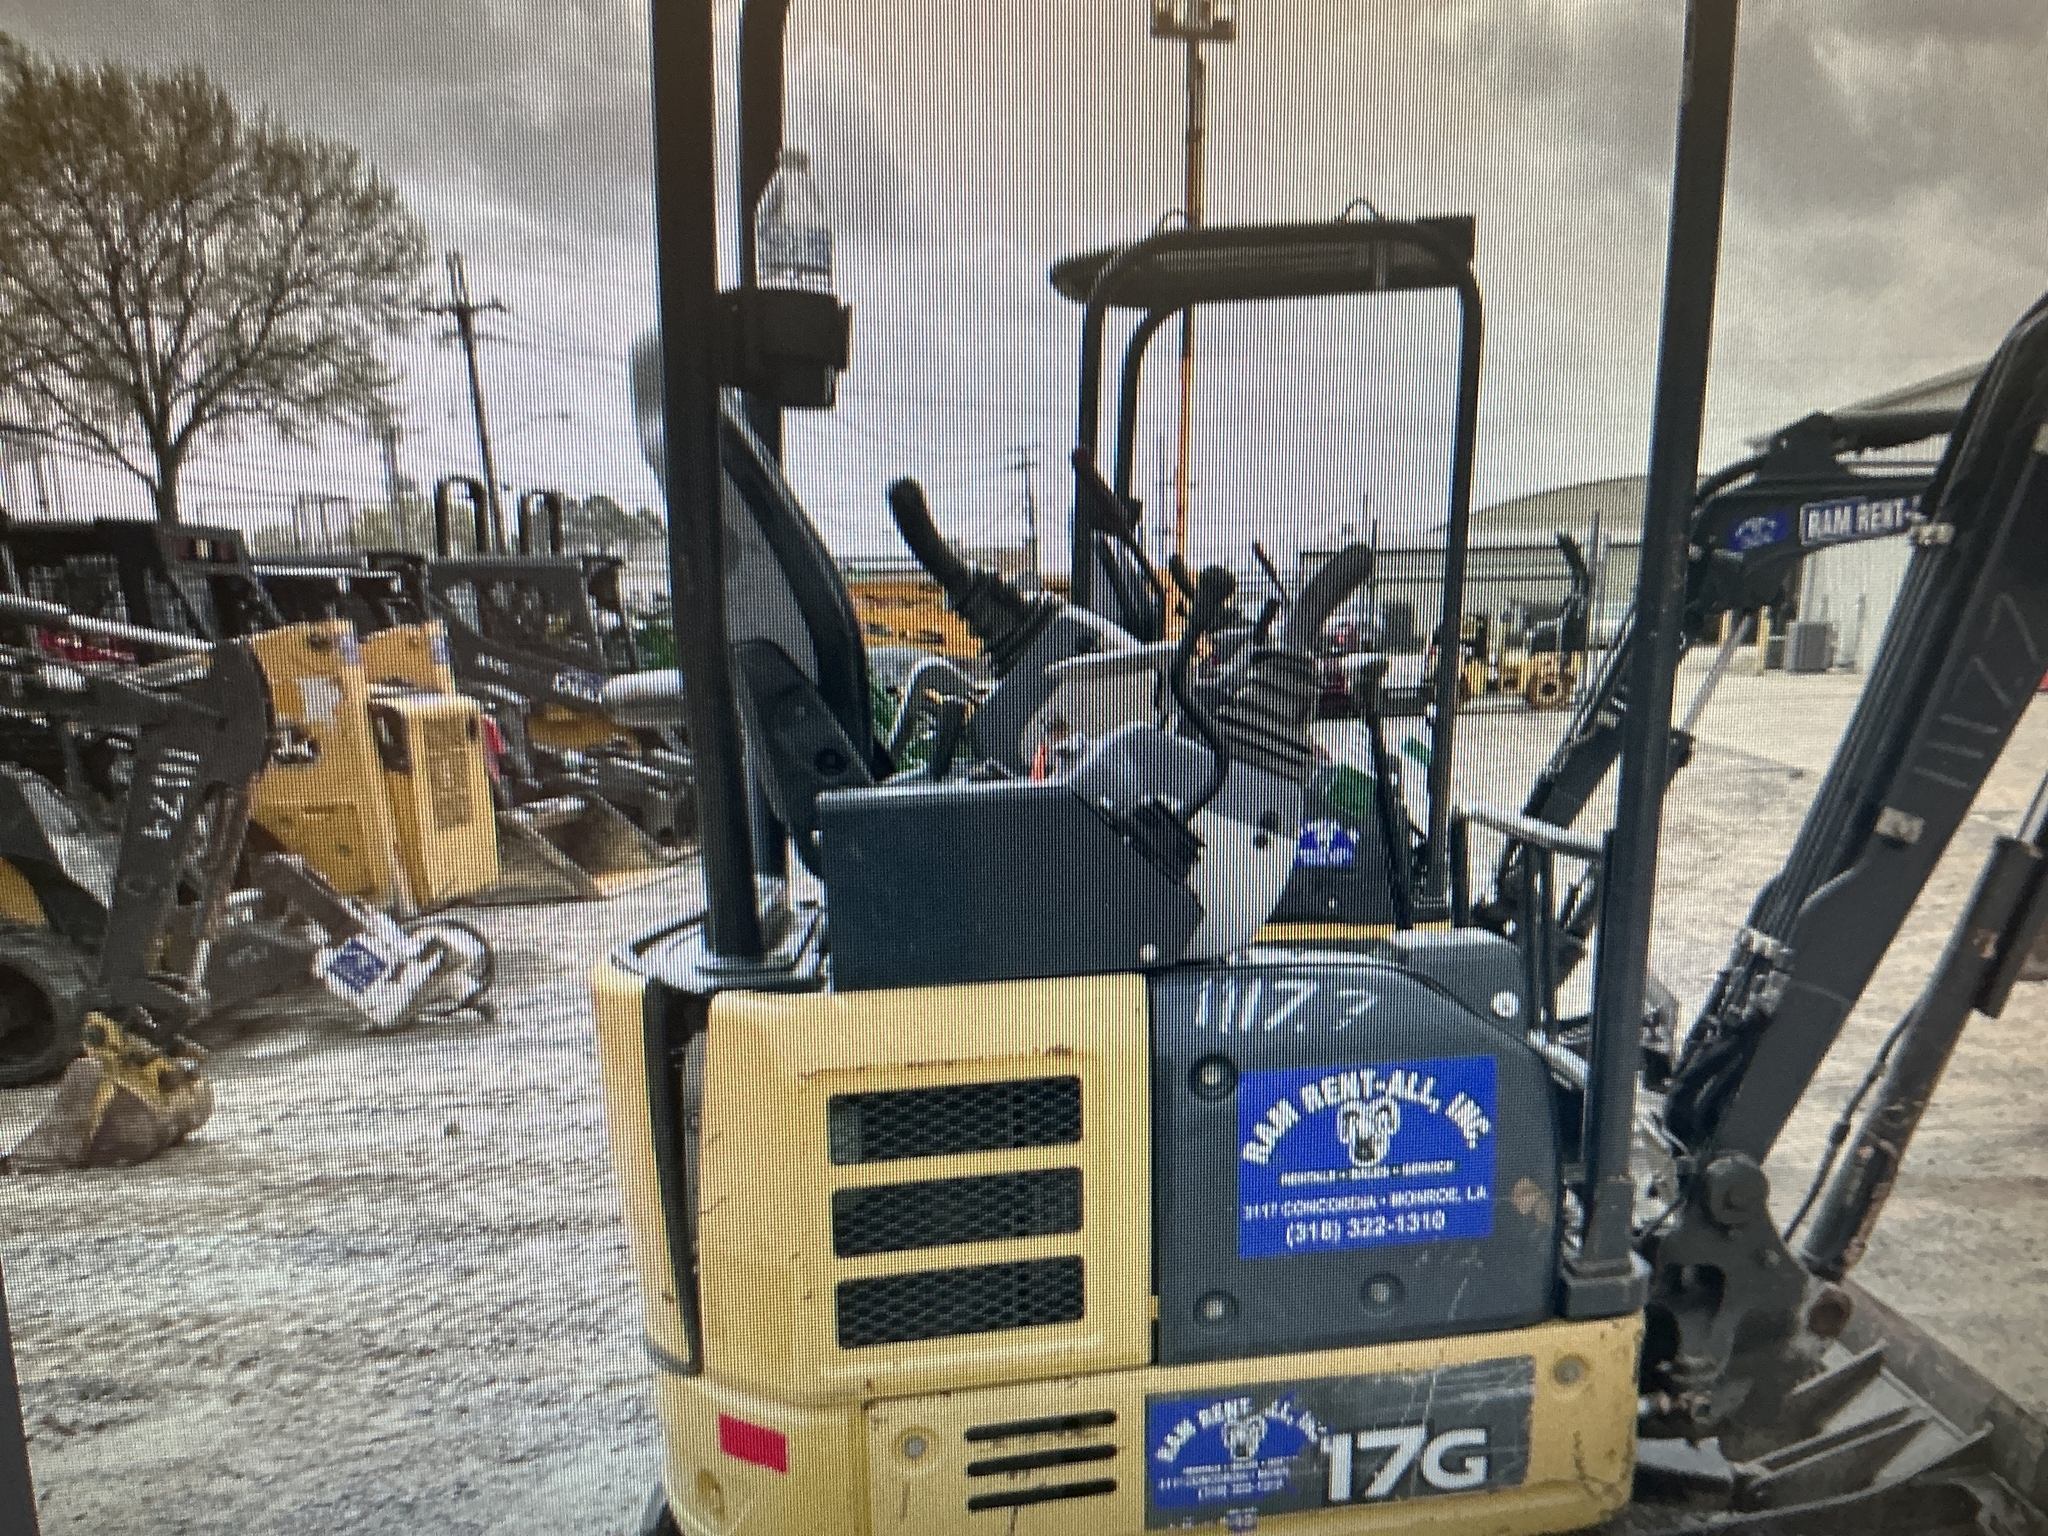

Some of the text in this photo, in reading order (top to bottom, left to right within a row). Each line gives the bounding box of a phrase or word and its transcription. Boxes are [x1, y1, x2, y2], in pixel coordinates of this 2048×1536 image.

[1807, 504, 1851, 539] RAM
[1242, 1068, 1492, 1166] RAM RENT-ALL, INC.
[1280, 1194, 1378, 1218] CONCORDIA
[1465, 1185, 1488, 1202] LA
[1284, 1210, 1447, 1249] (318) 322-1310
[1321, 1425, 1489, 1502] 17G
